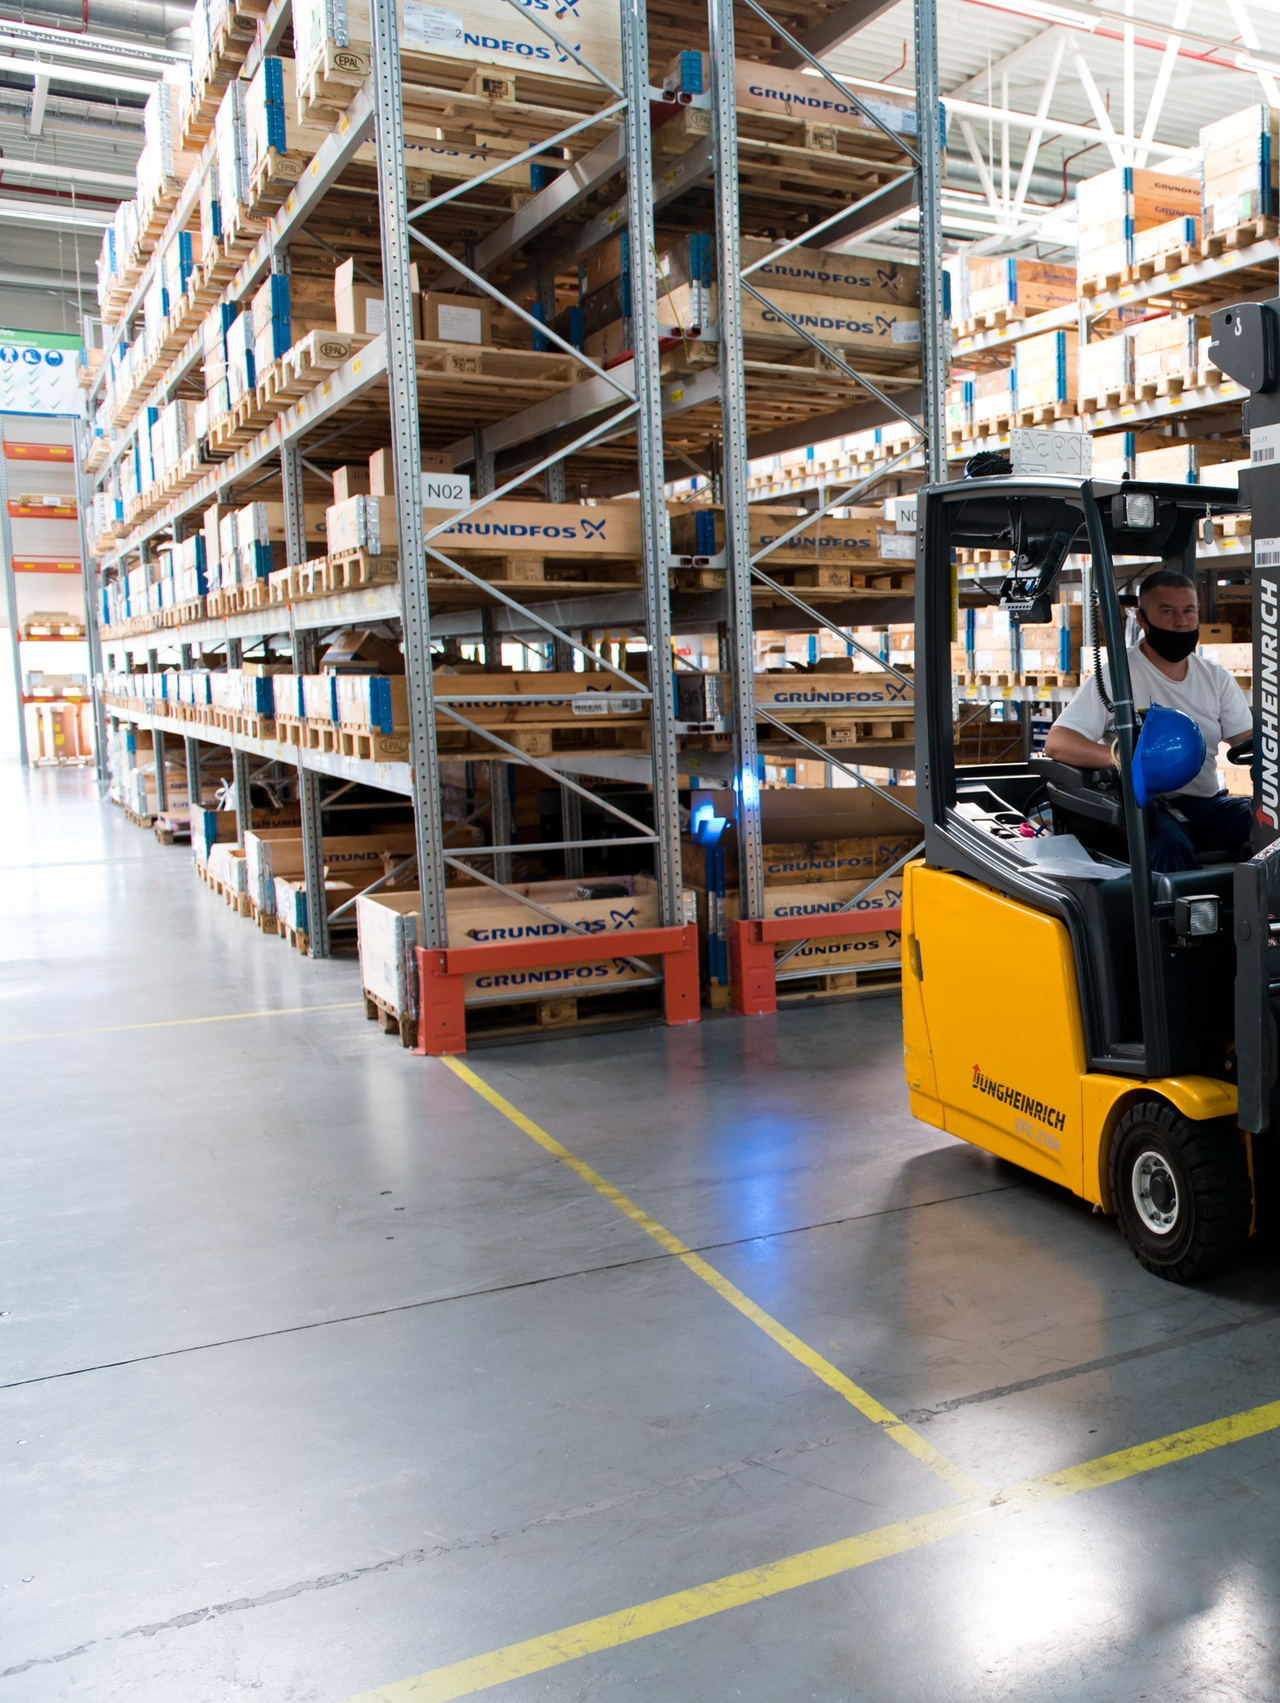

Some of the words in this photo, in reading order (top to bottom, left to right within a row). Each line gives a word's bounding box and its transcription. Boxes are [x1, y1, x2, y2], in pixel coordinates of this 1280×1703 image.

[464, 32, 551, 60] NDFOS
[338, 56, 360, 68] EPAL
[749, 85, 862, 117] GRUNDFOS
[1154, 182, 1200, 196] GRUNDFO
[759, 263, 872, 288] GRUNDFOS
[324, 345, 342, 355] EPAL
[427, 482, 464, 501] N02
[900, 509, 918, 523] N0
[759, 534, 871, 548] GUNDFOS
[773, 691, 885, 704] GRUNDFOS
[1260, 578, 1279, 830] JUNGHEINRICH
[767, 855, 874, 875] GRUNDFOS
[475, 963, 609, 990] GRUNDFOS
[971, 1071, 1067, 1132] JUNGHEINRICH
[1014, 1116, 1035, 1140] EFG
